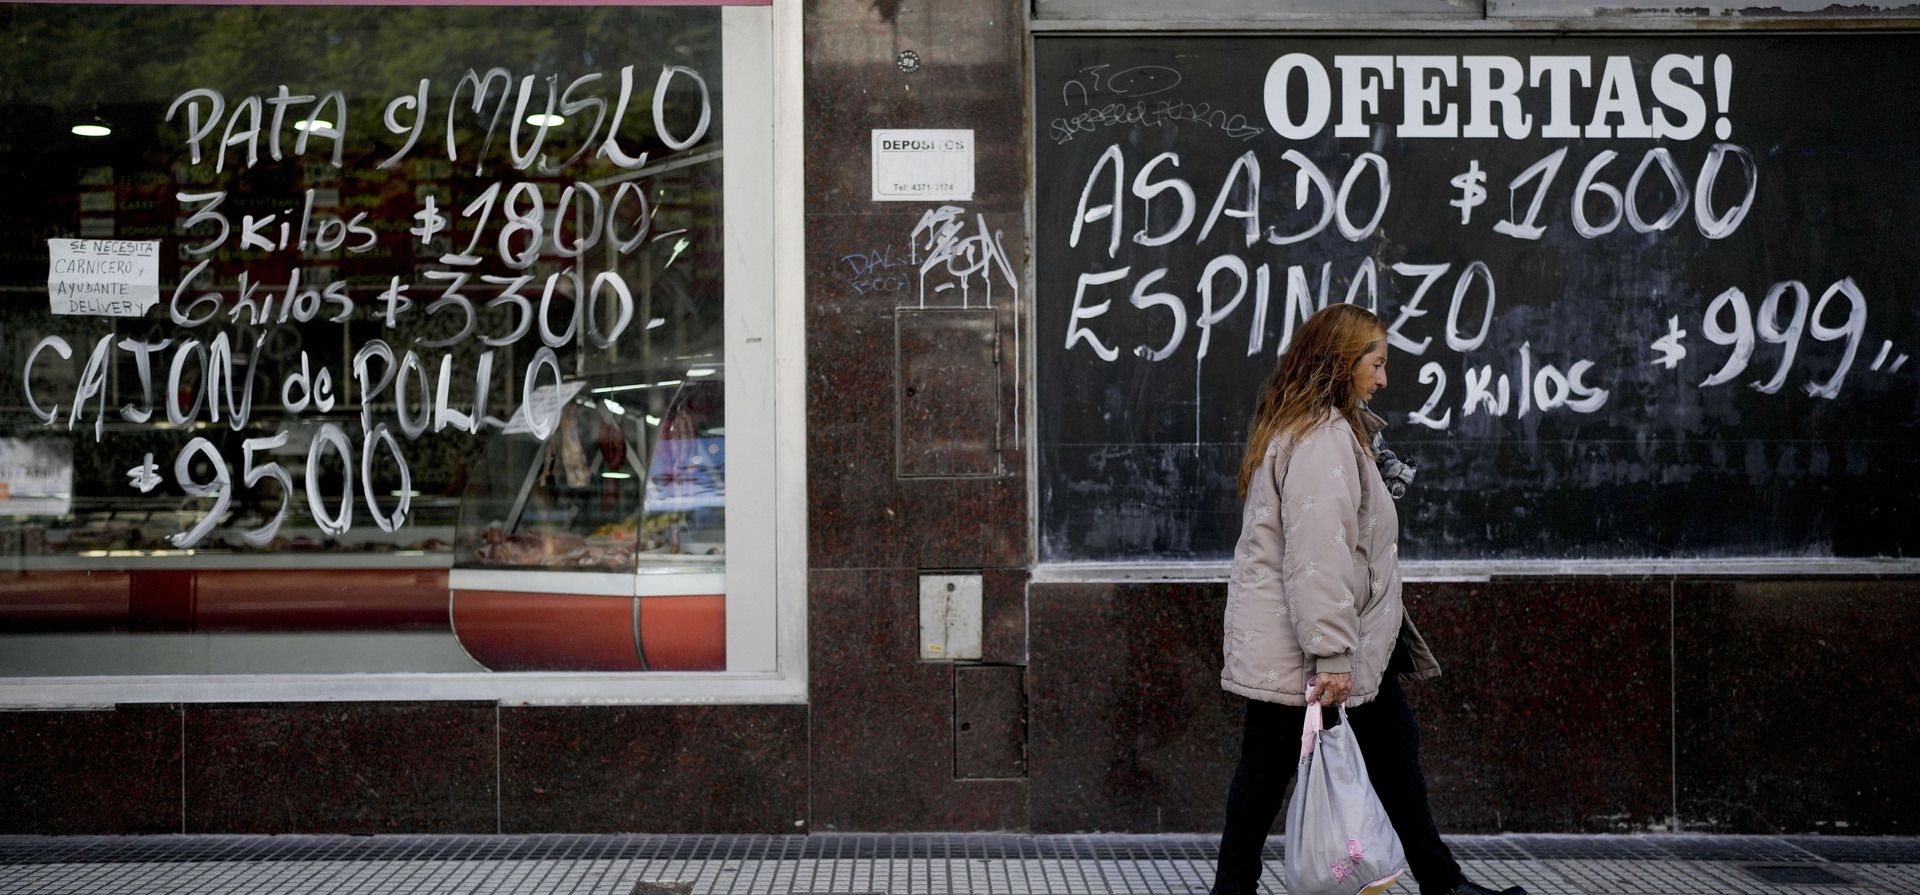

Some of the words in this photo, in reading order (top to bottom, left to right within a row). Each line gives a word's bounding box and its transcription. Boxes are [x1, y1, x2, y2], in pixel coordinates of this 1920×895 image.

[447, 65, 712, 177] MUSLO
[1264, 53, 1733, 140] OFERTAS!
[883, 140, 964, 150] DEPOSIOS
[176, 190, 230, 254] 3
[1070, 144, 1392, 259] ASADO
[54, 258, 133, 275] CARNICERO
[70, 240, 87, 250] SE
[93, 240, 153, 253] NECESITA
[57, 280, 129, 298] AYUDANTE
[170, 259, 224, 328] 6
[24, 330, 268, 443] CAJON
[281, 350, 335, 413] de
[354, 338, 562, 441] POLLO
[1408, 361, 1451, 430] 2
